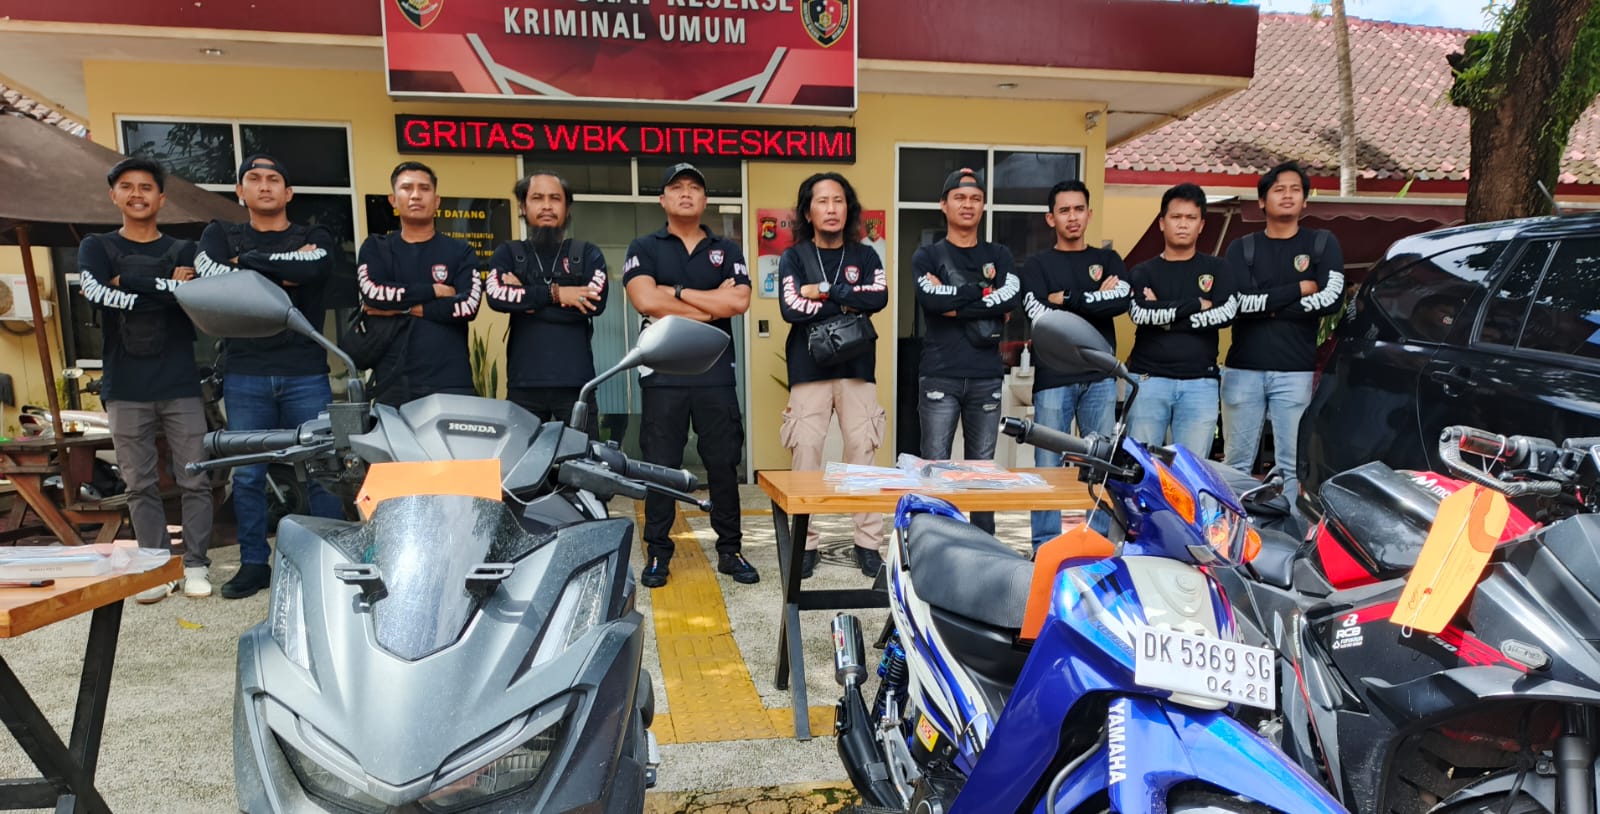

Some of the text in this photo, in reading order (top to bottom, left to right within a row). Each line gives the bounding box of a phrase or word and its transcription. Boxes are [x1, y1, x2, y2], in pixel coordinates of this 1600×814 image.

[503, 7, 746, 44] KRIMINAL UMUM
[403, 119, 536, 150] GRITAS
[543, 124, 630, 152] WBK
[444, 209, 486, 219] DATANG
[448, 422, 497, 434] HONDA
[1335, 626, 1361, 640] RCB
[1144, 632, 1172, 663] DK
[1181, 638, 1236, 673] 5369
[1244, 651, 1271, 681] SG
[1108, 698, 1127, 786] YAMAHA
